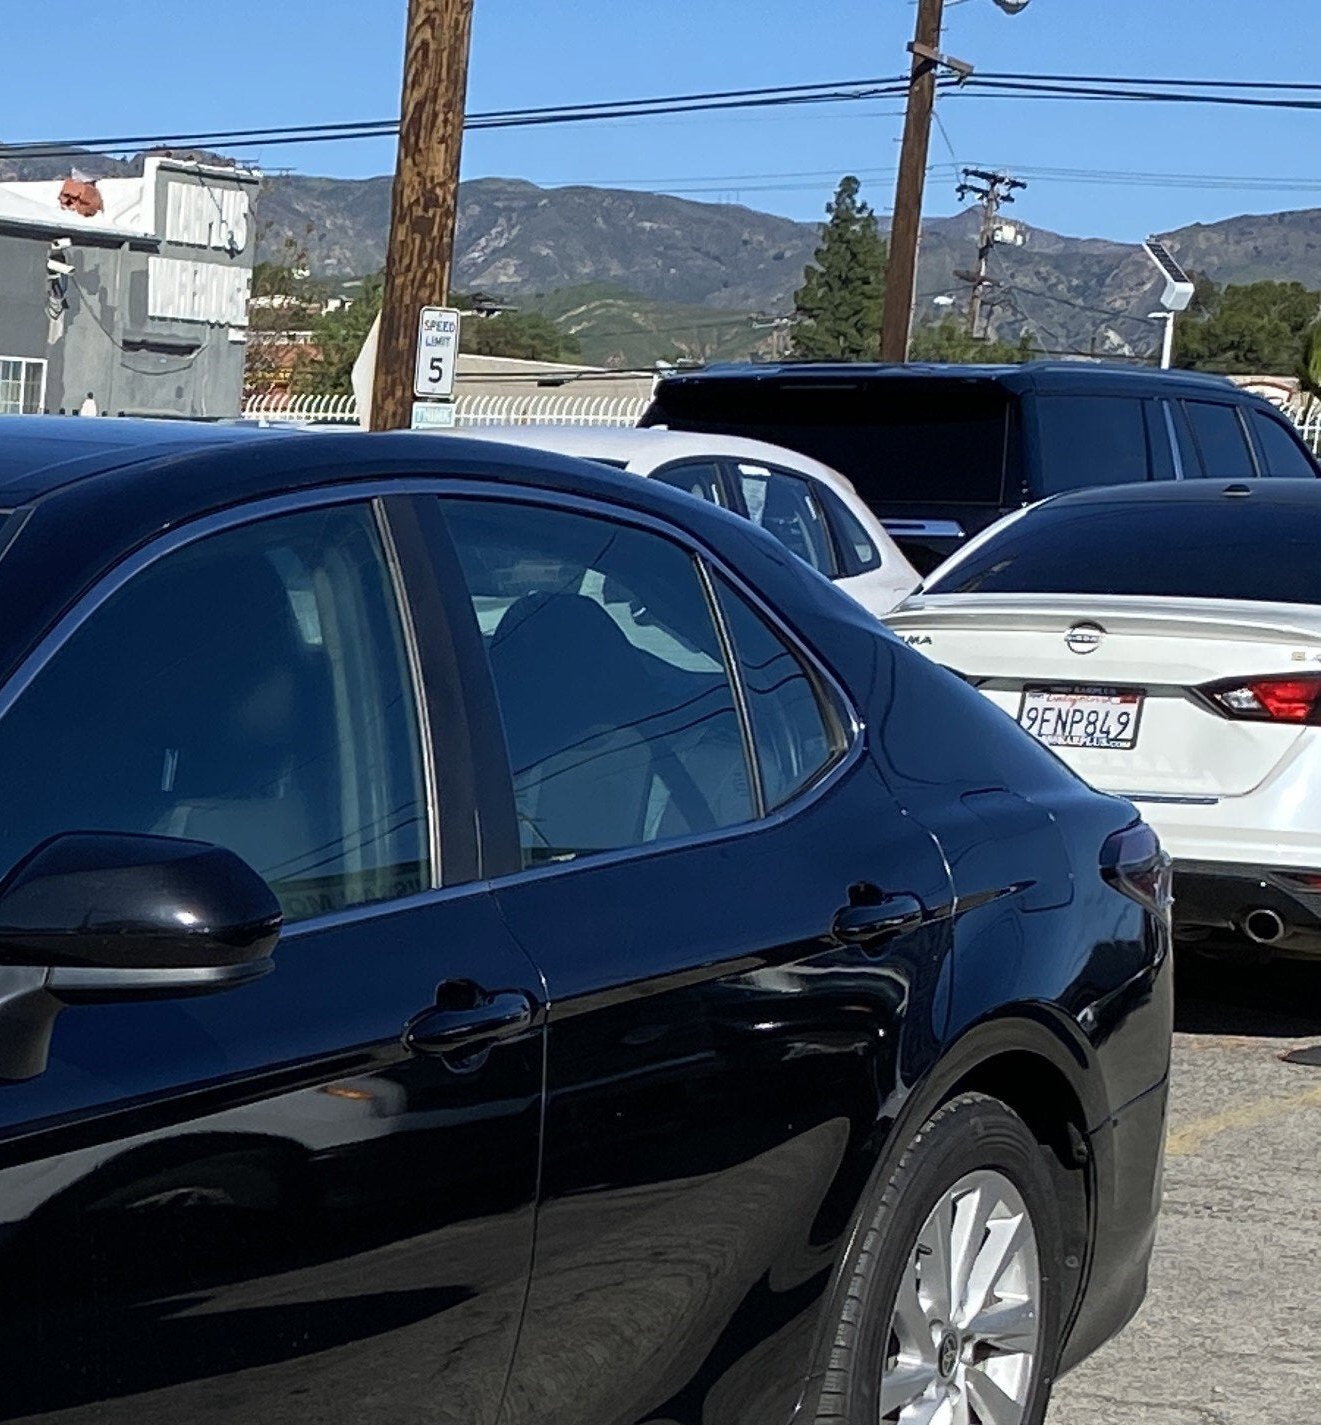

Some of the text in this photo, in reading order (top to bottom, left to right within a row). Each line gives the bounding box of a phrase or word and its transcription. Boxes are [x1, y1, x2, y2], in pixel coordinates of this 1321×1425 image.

[424, 320, 456, 332] SPEED
[425, 336, 452, 347] LIMIT
[428, 357, 443, 383] 5
[1026, 707, 1131, 741] 9ENP849
